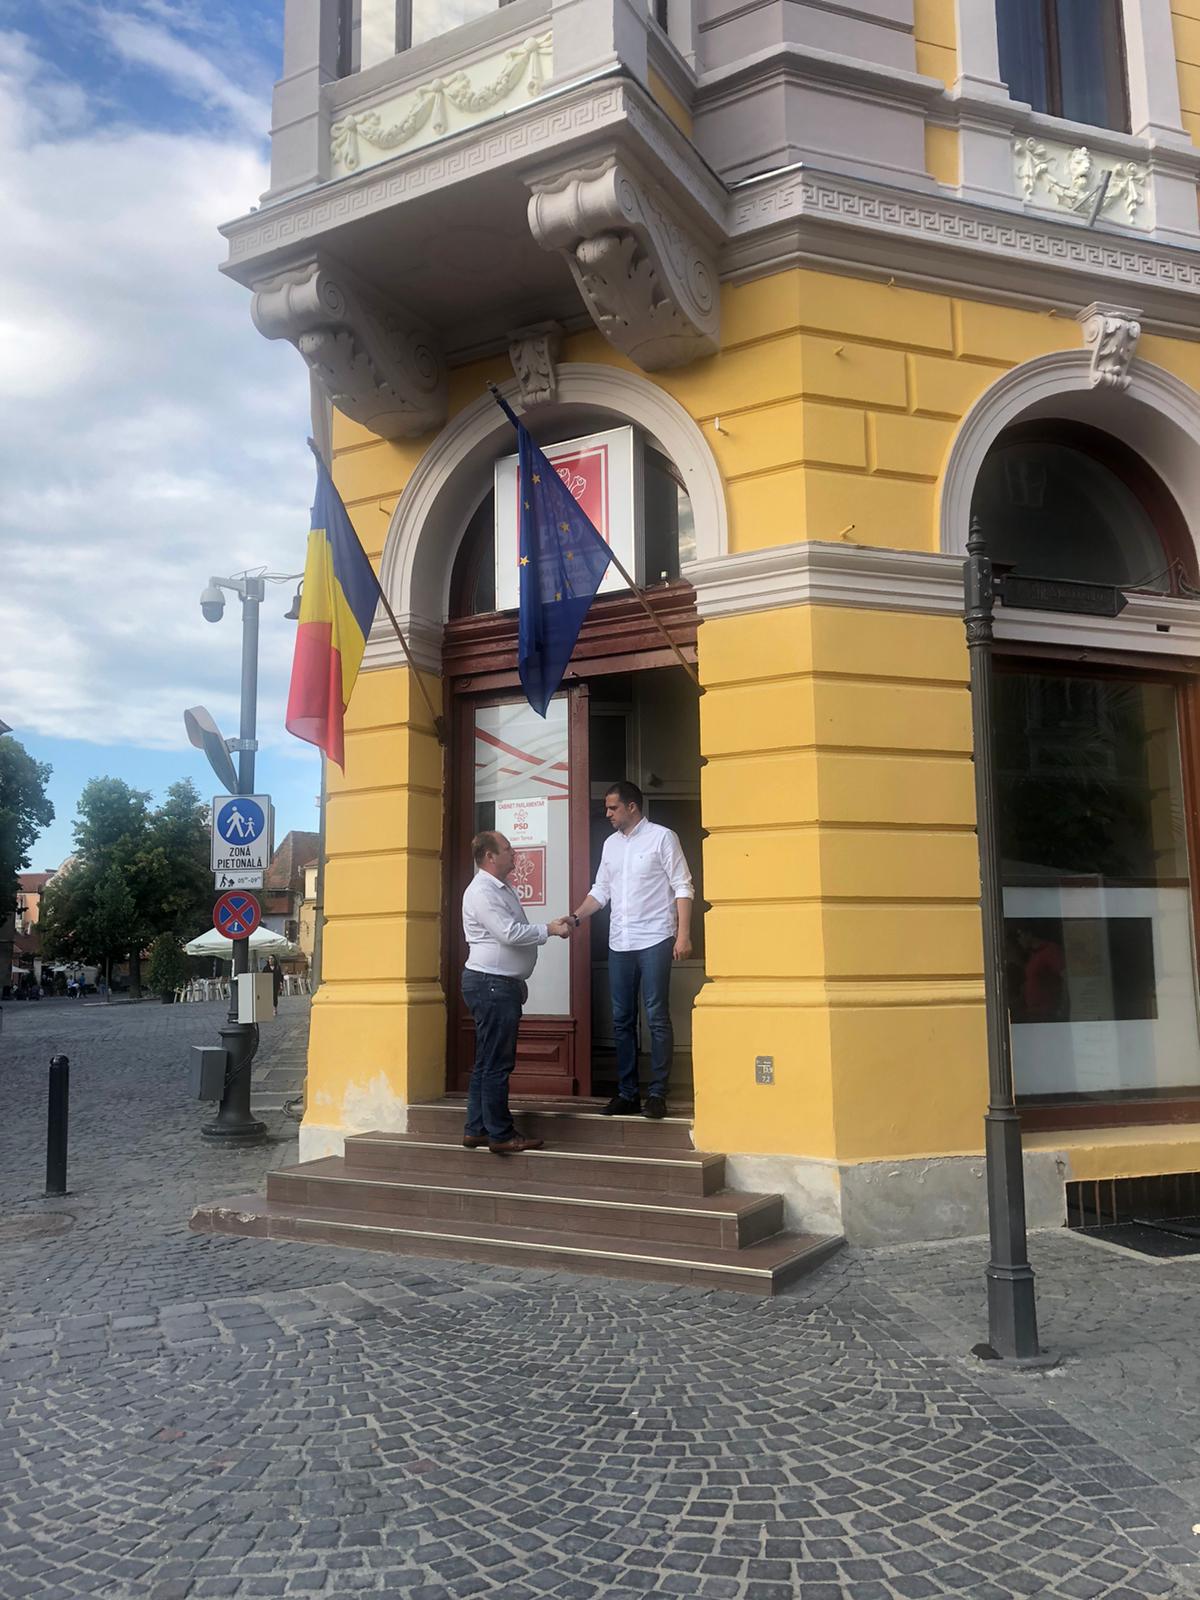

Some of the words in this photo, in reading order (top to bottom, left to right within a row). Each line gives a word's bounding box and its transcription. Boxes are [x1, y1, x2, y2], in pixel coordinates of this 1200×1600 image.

[229, 846, 251, 857] ZONĂ
[217, 857, 262, 869] PIETONALĂ
[513, 884, 533, 899] SD
